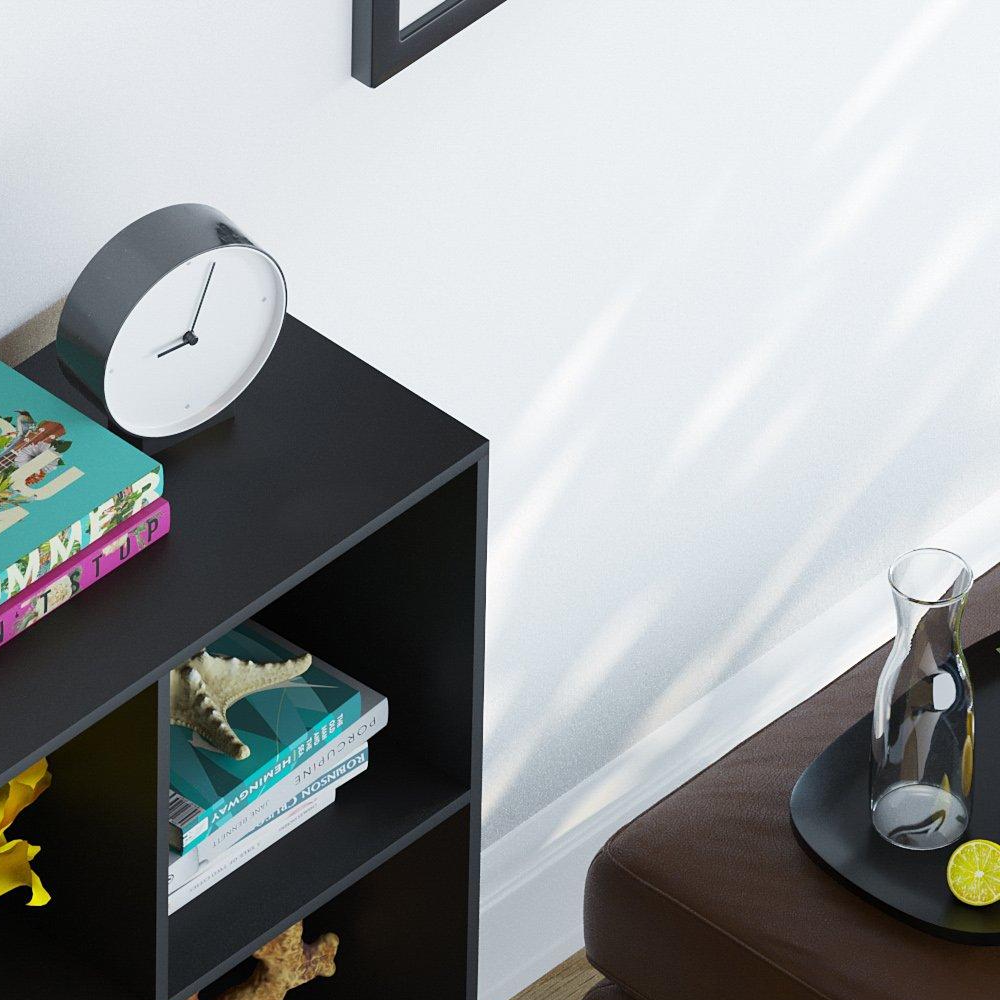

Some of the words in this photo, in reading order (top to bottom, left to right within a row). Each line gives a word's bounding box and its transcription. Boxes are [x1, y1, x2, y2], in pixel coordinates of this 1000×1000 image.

[294, 717, 377, 786] PORCUPINE
[301, 752, 366, 799] ROBINSON
[212, 753, 292, 824] HEMINGWAY
